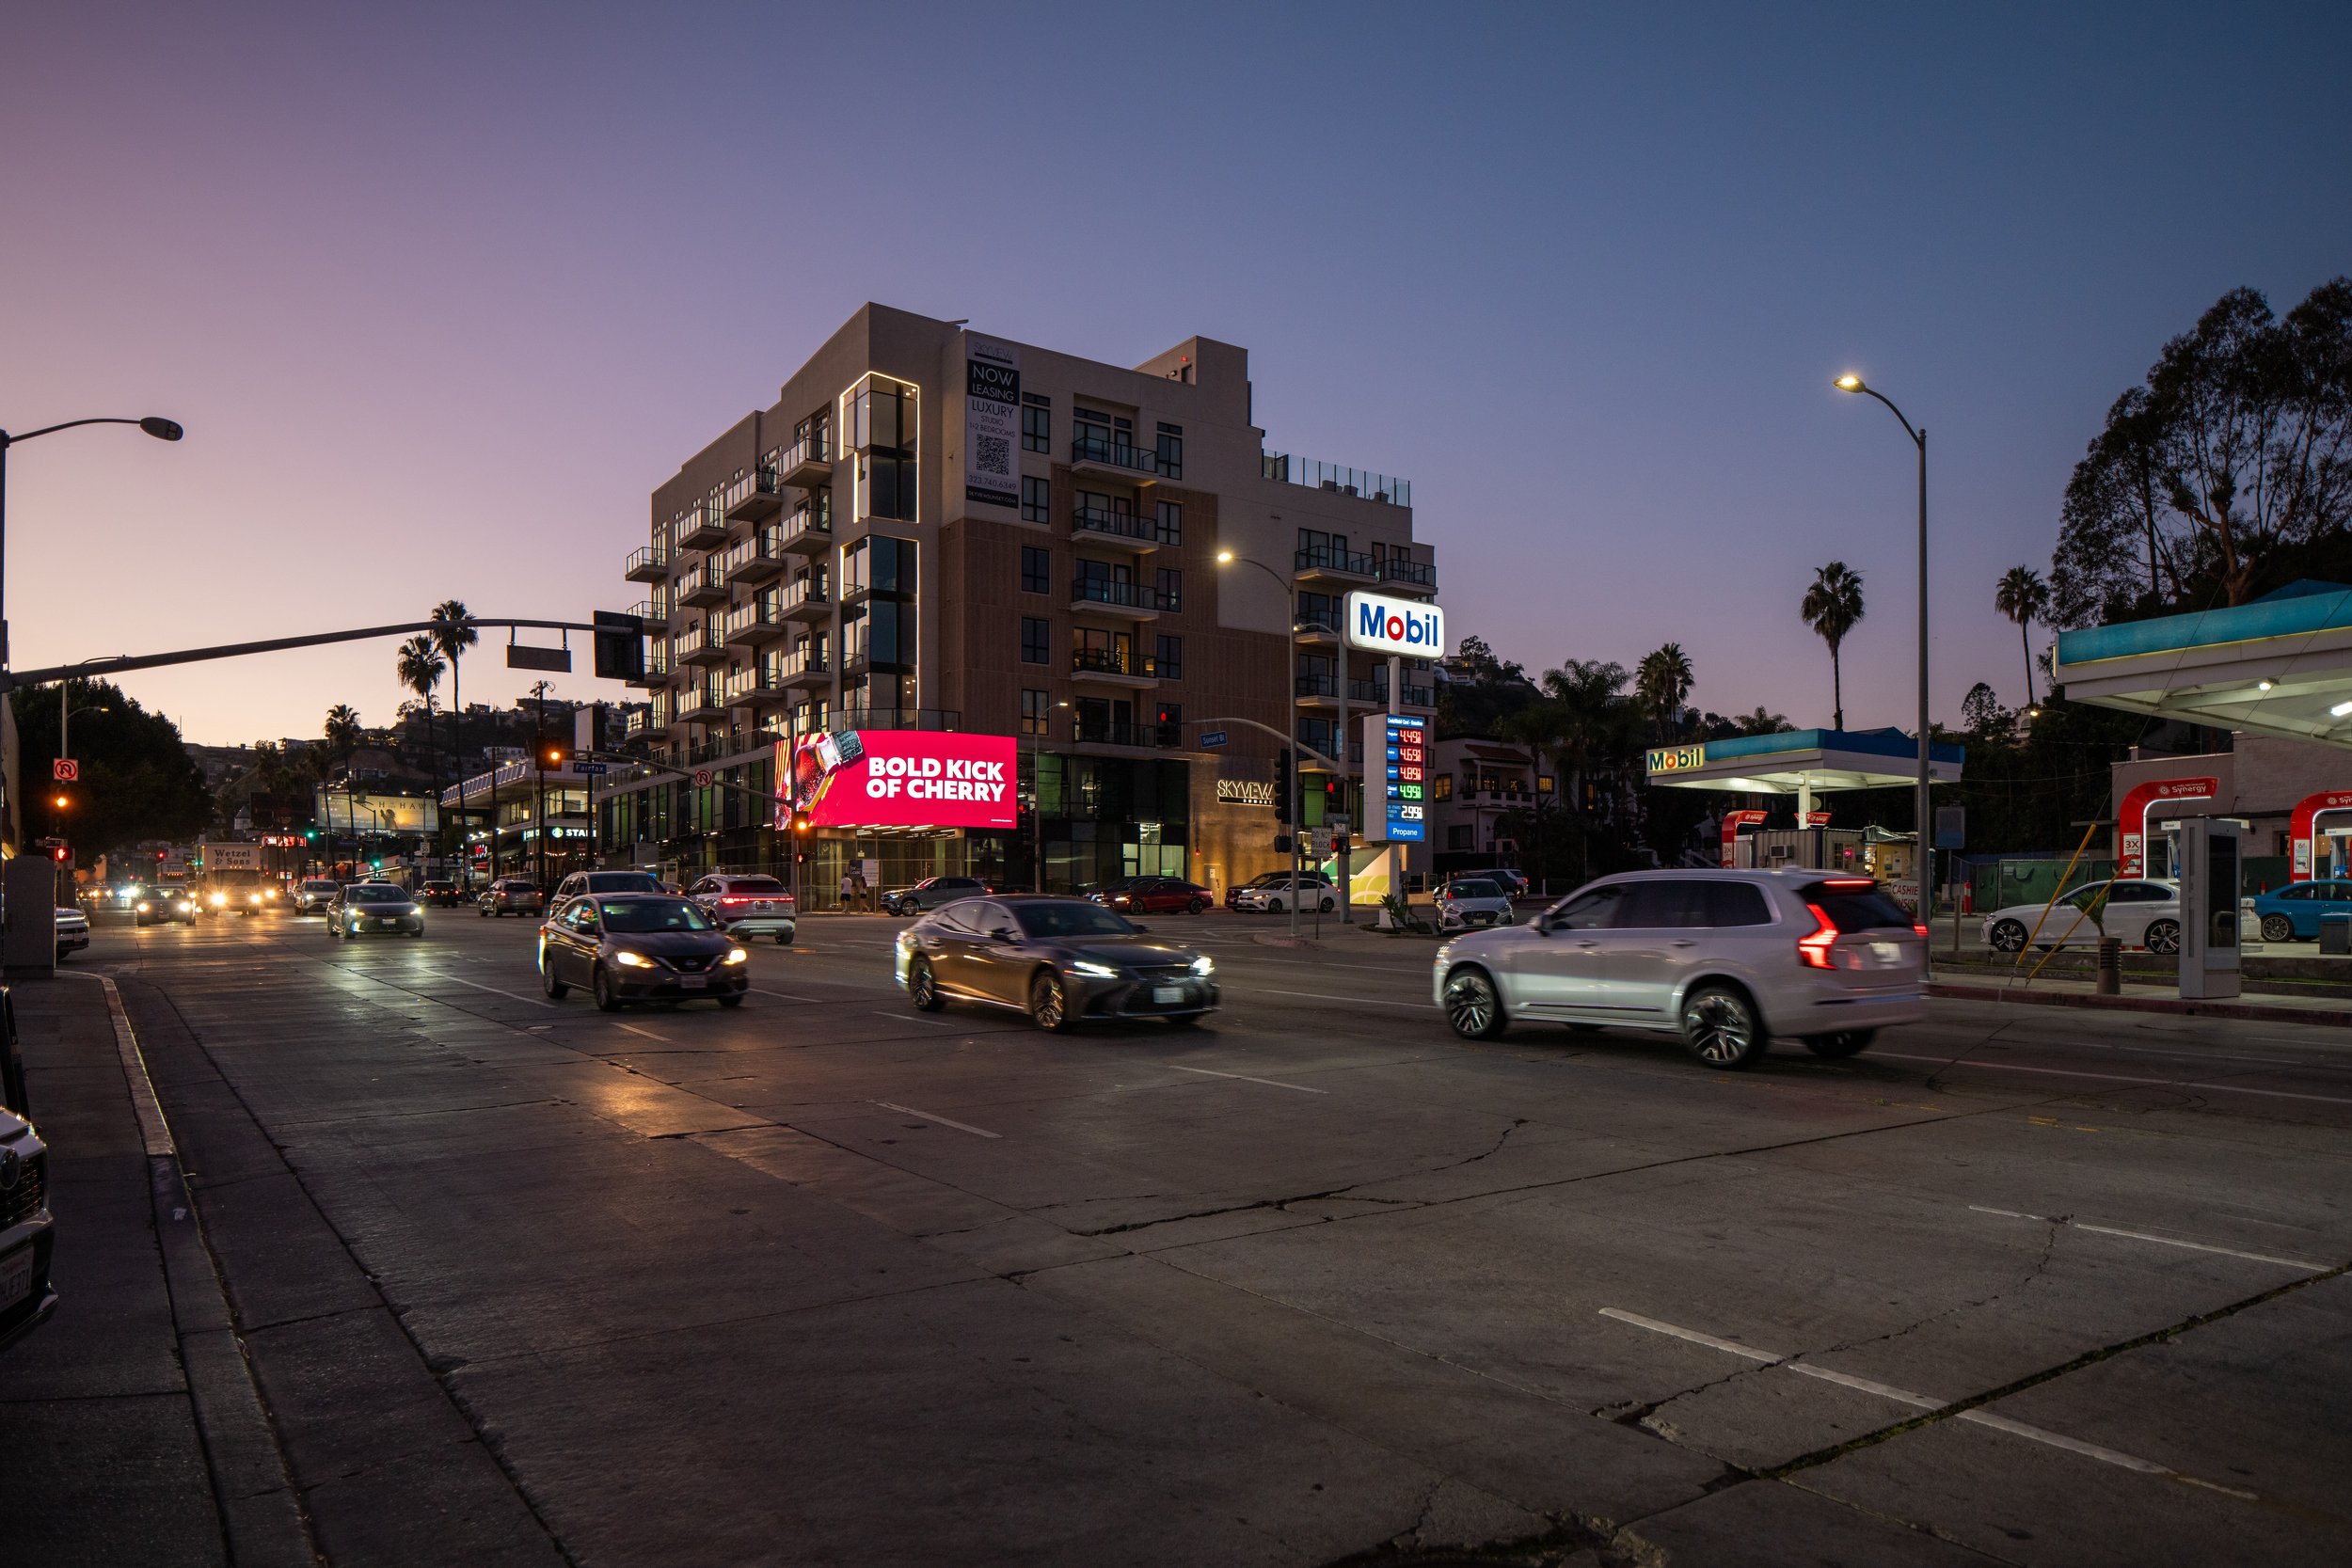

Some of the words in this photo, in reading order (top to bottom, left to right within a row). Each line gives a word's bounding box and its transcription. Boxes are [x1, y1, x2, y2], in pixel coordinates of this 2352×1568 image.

[973, 364, 1013, 386] NOW
[972, 383, 1014, 402] LEASING
[972, 399, 1013, 419] LUXURY
[980, 416, 1004, 426] STUDIO
[979, 424, 1016, 438] BEDROOMS
[968, 475, 1016, 490] 323.740.6349
[1360, 602, 1438, 647] Mobil
[1202, 736, 1218, 745] Sunset
[1649, 749, 1700, 769] Mobil
[575, 764, 604, 772] Fairfax
[868, 756, 942, 778] BOLD
[946, 759, 1005, 782] KICK
[866, 779, 901, 799] OF
[906, 780, 1007, 802] CHERRY
[2171, 784, 2206, 794] Synergy
[1393, 828, 1417, 836] Propane
